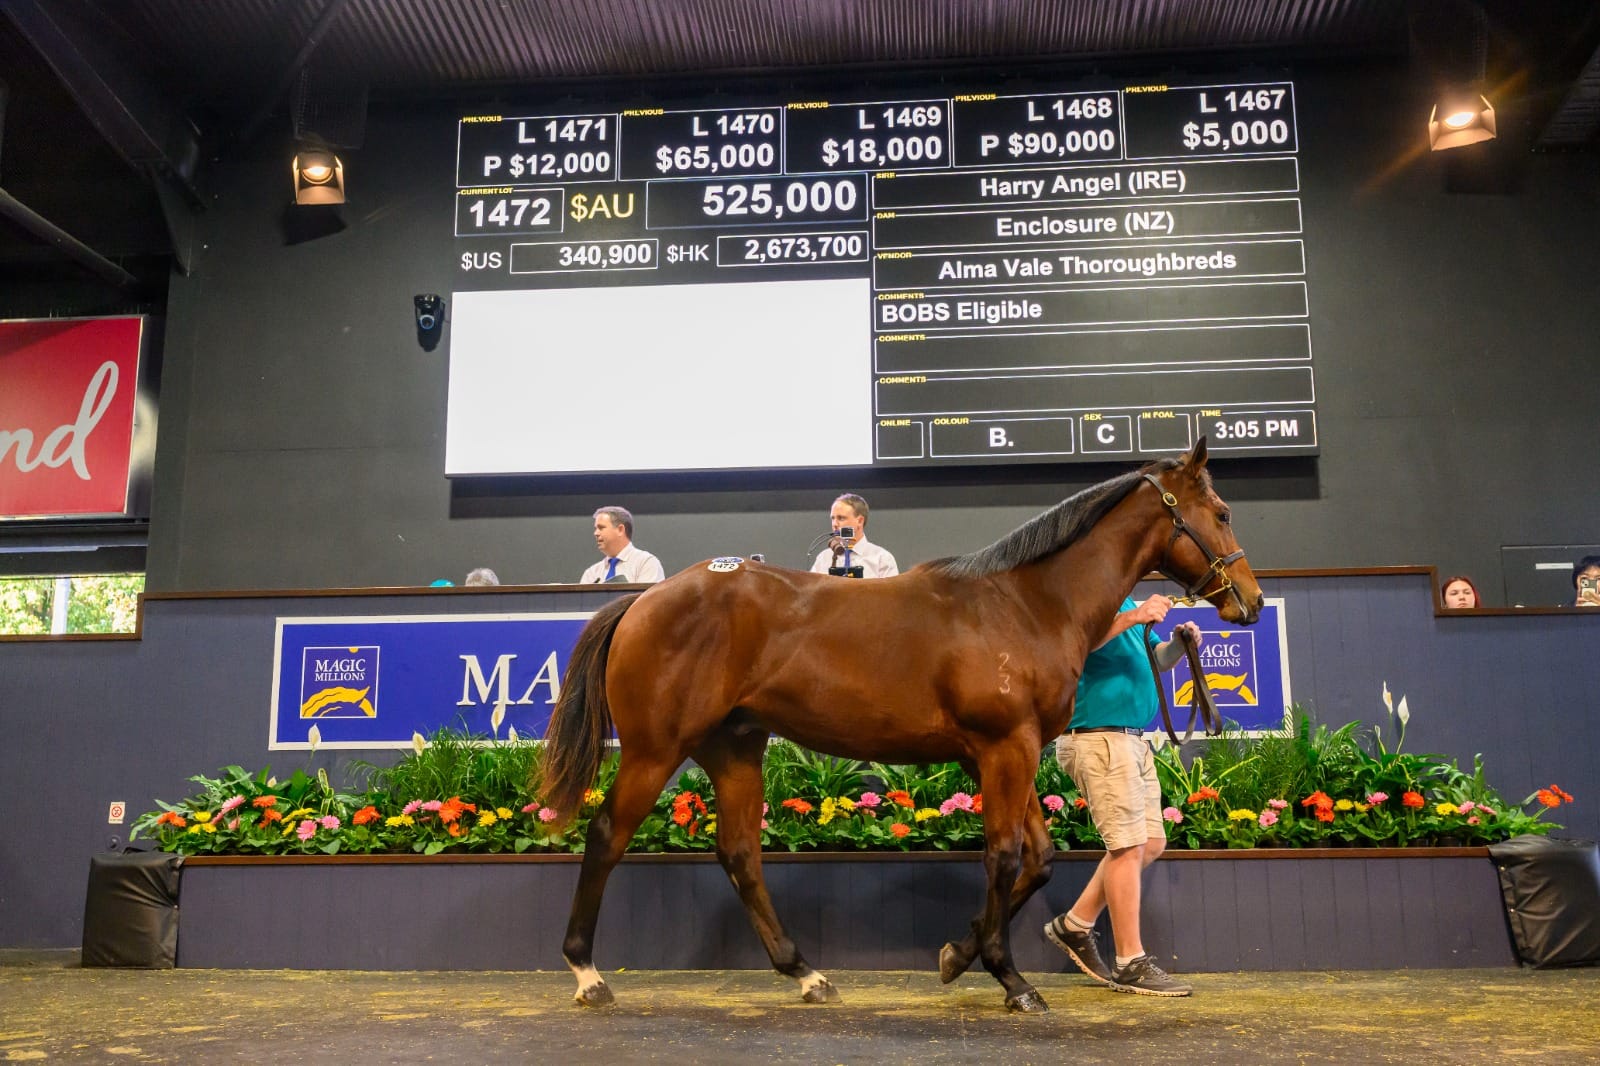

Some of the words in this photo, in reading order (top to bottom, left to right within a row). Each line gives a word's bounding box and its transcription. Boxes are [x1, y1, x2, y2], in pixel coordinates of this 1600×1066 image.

[1028, 102, 1044, 121] L
[1053, 98, 1112, 119] 1468
[1200, 93, 1217, 113] L
[1225, 90, 1285, 111] 1467
[693, 117, 708, 136] L
[717, 114, 774, 135] 1470
[859, 110, 875, 129] L
[883, 106, 941, 127] 1469
[519, 122, 535, 143] L
[545, 118, 607, 143] 1471
[1183, 120, 1288, 150] $5,000
[822, 135, 943, 166] $18,000
[982, 135, 999, 156] P
[1008, 129, 1114, 157] $90,000
[484, 156, 501, 176] P
[510, 152, 610, 178] $12,000
[656, 143, 774, 173] $65,000
[981, 178, 1044, 198] Harry
[1051, 173, 1120, 196] Angel
[1129, 169, 1186, 194] (IRE)
[570, 193, 635, 222] $AU
[703, 179, 856, 218] 525,000
[470, 198, 550, 227] 1472
[876, 211, 896, 219] DAM
[997, 217, 1117, 236] Enclosure
[1125, 211, 1174, 235] (NZ)
[559, 243, 651, 269] 340,900
[667, 245, 709, 263] $HK
[744, 235, 862, 263] 2,673,700
[461, 252, 501, 271] $US
[939, 261, 997, 279] Alma
[1003, 258, 1053, 276] Vale
[1059, 251, 1237, 275] Thoroughbreds
[878, 292, 924, 300] COMMENTS
[882, 303, 951, 323] BOBS
[958, 300, 1043, 324] Eligible
[879, 334, 926, 342] COMMENTS
[880, 376, 926, 384] COMMENTS
[990, 428, 1013, 447] B.
[1097, 424, 1114, 443] C
[1215, 421, 1259, 438] 3:05
[1266, 420, 1298, 437] PM
[1200, 644, 1240, 658] AGIC
[314, 658, 366, 672] MAGIC
[314, 672, 366, 682] MILLIONS
